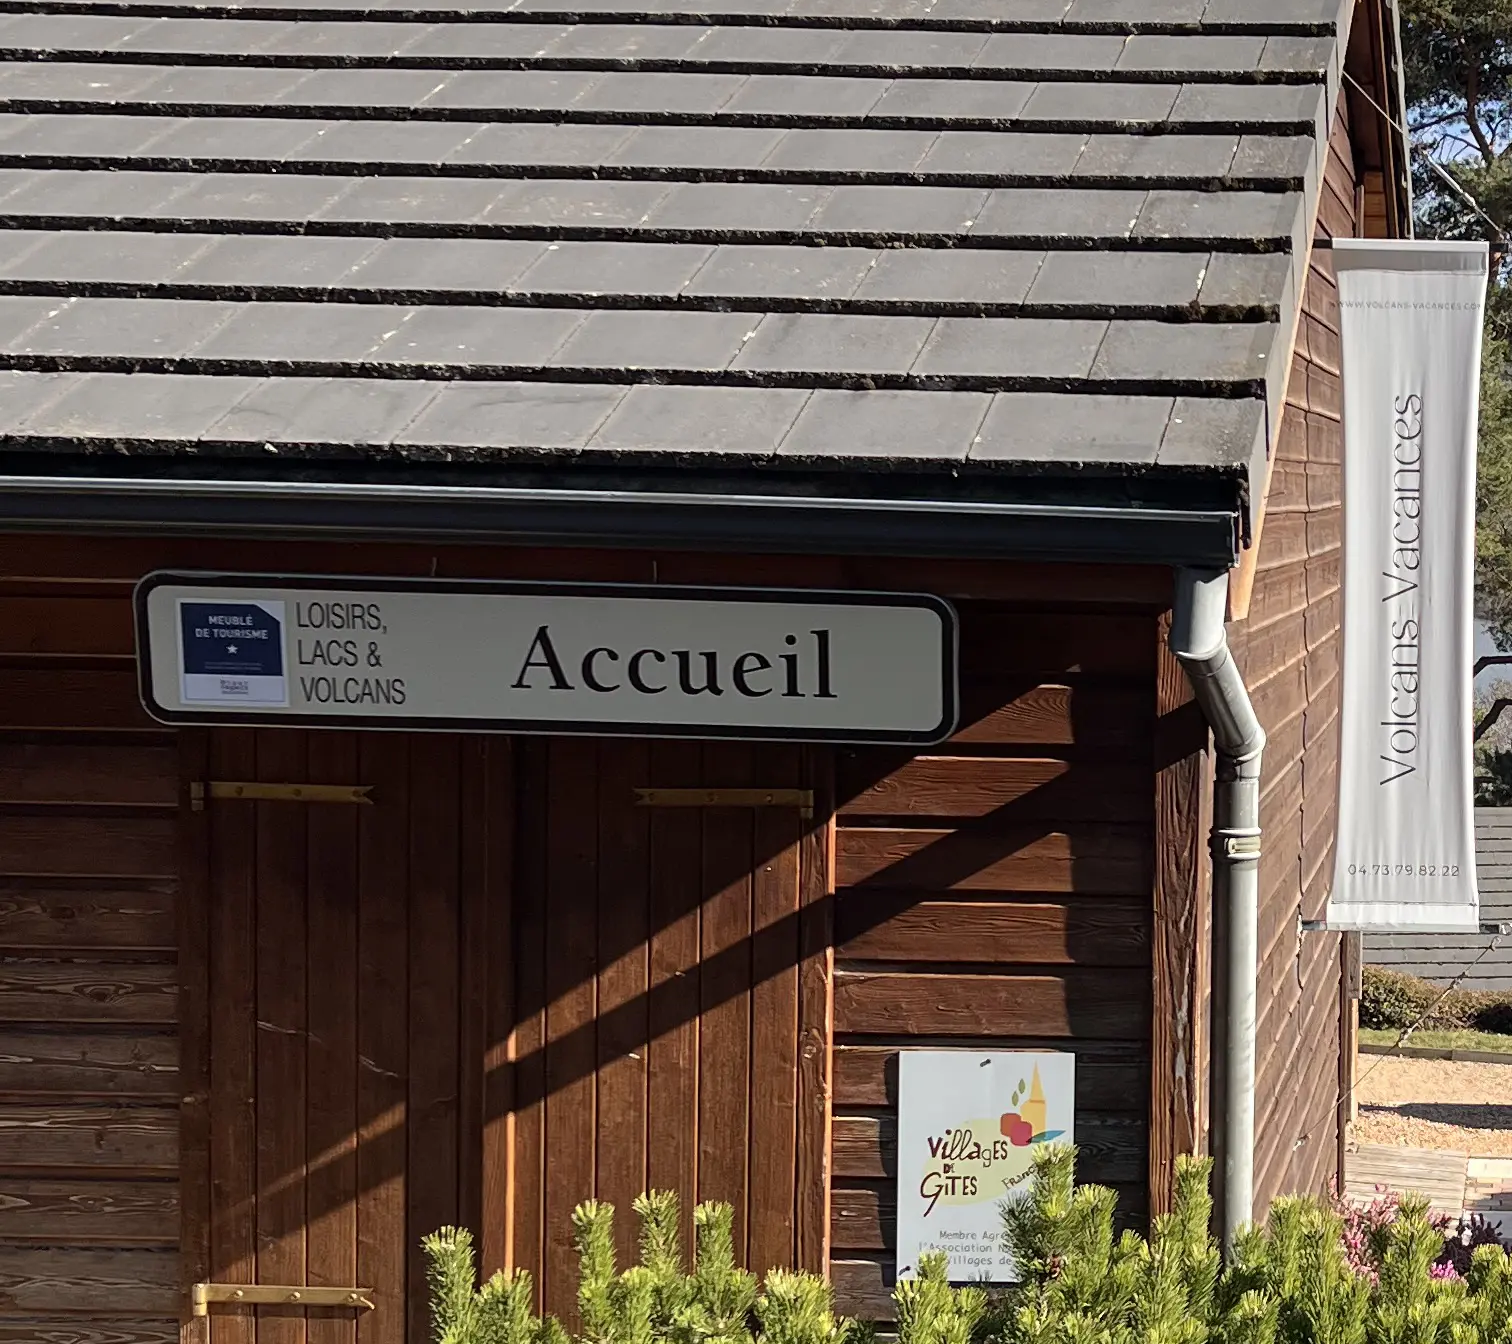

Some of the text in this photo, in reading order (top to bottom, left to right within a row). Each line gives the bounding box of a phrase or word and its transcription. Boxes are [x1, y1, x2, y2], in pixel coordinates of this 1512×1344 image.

[208, 614, 254, 626] MEUBLÉ
[296, 602, 388, 634] LOISIRS,
[195, 628, 269, 640] DE TOURISME
[298, 639, 383, 668] LACS &
[510, 625, 838, 698] Accueil
[300, 677, 406, 705] VOLCANS
[1347, 863, 1460, 877] 04.73.79.82.22
[939, 1230, 977, 1240] Membre
